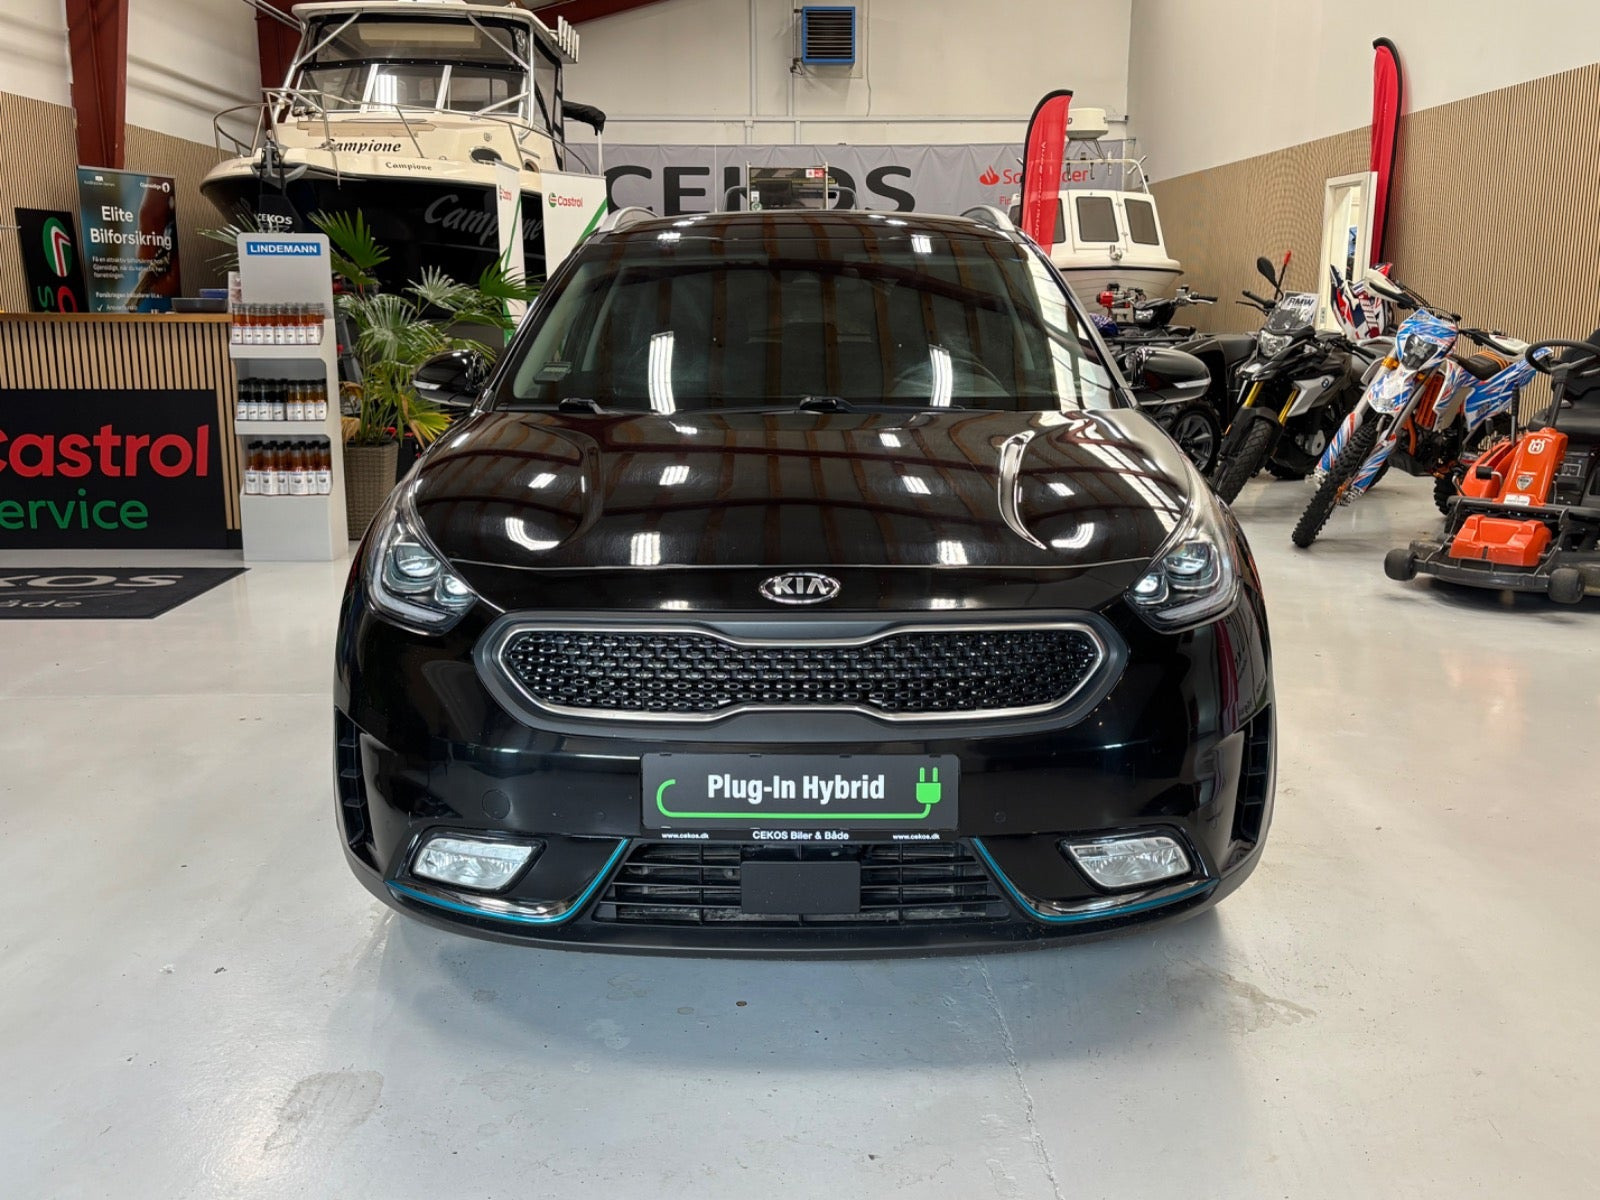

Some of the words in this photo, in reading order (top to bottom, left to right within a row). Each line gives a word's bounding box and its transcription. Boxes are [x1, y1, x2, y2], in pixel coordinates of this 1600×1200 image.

[385, 161, 433, 171] Campione
[557, 195, 583, 208] Castrol
[101, 205, 134, 223] Elite
[424, 193, 543, 245] Campne
[90, 227, 172, 250] Bilforsikring
[250, 244, 317, 253] LINDEMANN
[0, 423, 209, 478] astrol
[0, 488, 148, 529] ervice
[773, 576, 828, 595] KIA
[707, 773, 796, 804] Plug-In
[802, 774, 885, 805] Hybrid
[661, 832, 709, 840] www.cekos.dk
[752, 830, 788, 840] CEKOS
[790, 830, 813, 840] Biler
[815, 830, 823, 840] &
[824, 829, 850, 841] Både
[892, 833, 940, 841] www.cekos.dk
